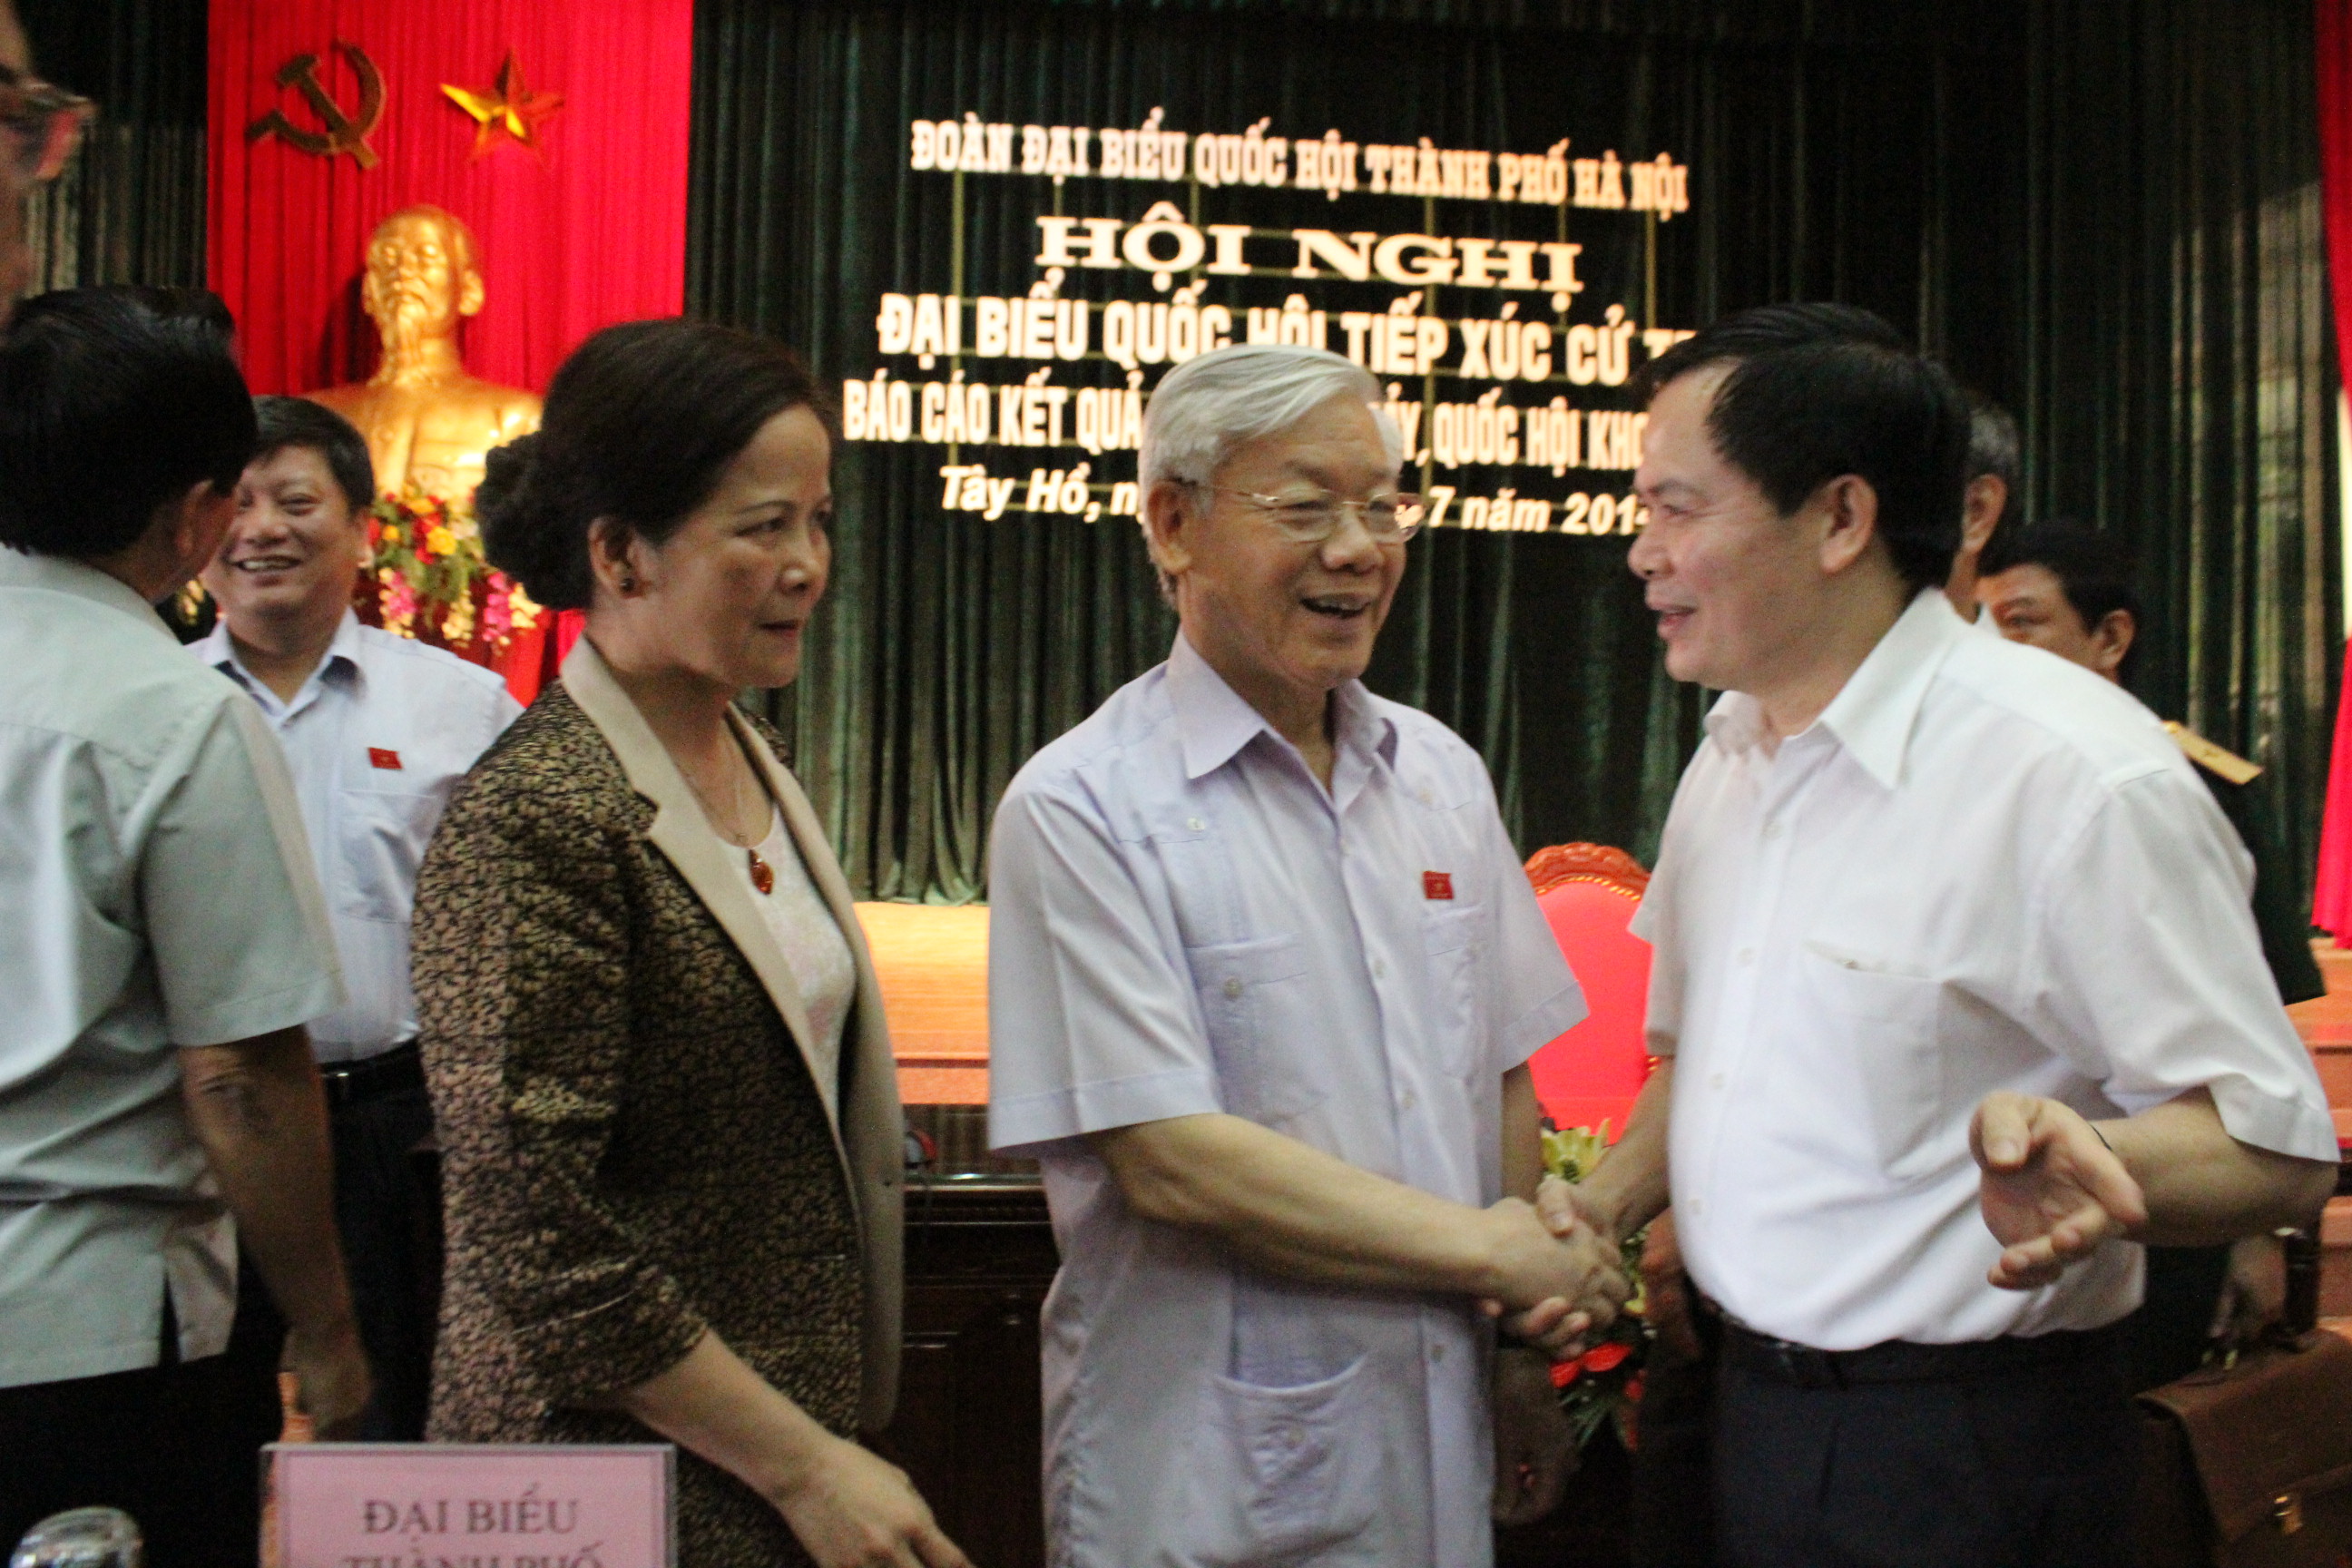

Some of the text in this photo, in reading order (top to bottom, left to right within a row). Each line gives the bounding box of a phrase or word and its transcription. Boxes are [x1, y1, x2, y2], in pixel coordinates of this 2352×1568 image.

[911, 106, 1689, 221] ĐOÀN ĐẠI BIỂU QUỐC HỘI THÀNH PHỐ HÀ NỘI
[1035, 201, 1584, 313] HỘI NGHỊ
[876, 293, 962, 370] ĐẠI
[975, 267, 1089, 358] BIỂU
[1103, 279, 1232, 370] QUỐC
[1340, 290, 1448, 375] TIẾP
[1459, 301, 1553, 381] XÚC
[1565, 304, 1635, 386] CỬ
[843, 368, 911, 442] BÁO
[920, 369, 990, 444] CÁO
[998, 367, 1069, 446] KẾT
[1076, 369, 1142, 456] QUẢ
[1433, 387, 1518, 469] QUỐC
[1526, 397, 1581, 477] HỘI
[940, 464, 1016, 521] Tây
[1427, 485, 1455, 528] 7
[1461, 487, 1552, 533] năm
